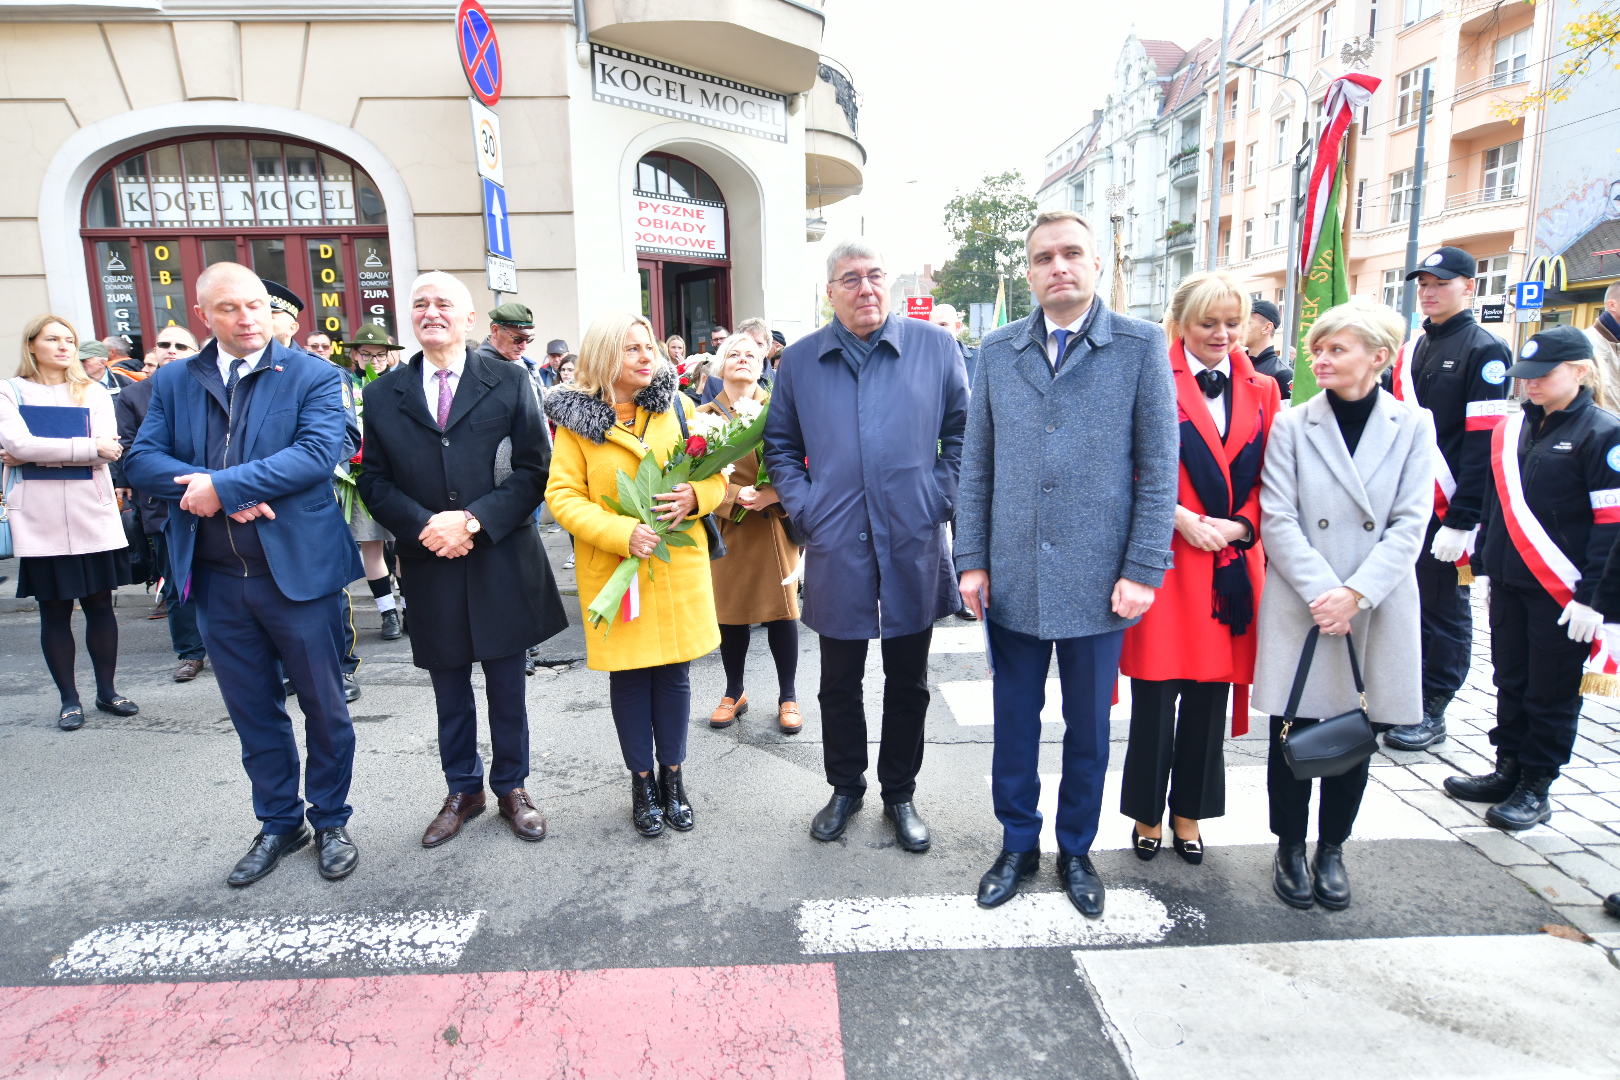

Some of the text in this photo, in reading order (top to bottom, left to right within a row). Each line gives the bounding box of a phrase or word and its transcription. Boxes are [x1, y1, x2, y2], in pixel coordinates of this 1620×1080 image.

[598, 61, 782, 127] KOGEL MOGEL
[482, 129, 496, 158] 30
[125, 189, 354, 212] KOGEL MOGEL
[638, 200, 705, 220] PYSZNE
[637, 216, 707, 234] OBIADY
[102, 275, 134, 284] OBIADY
[359, 271, 390, 280] OBIADY
[106, 293, 133, 303] ZUPA
[363, 289, 389, 299] ZUPA
[1521, 284, 1538, 306] P
